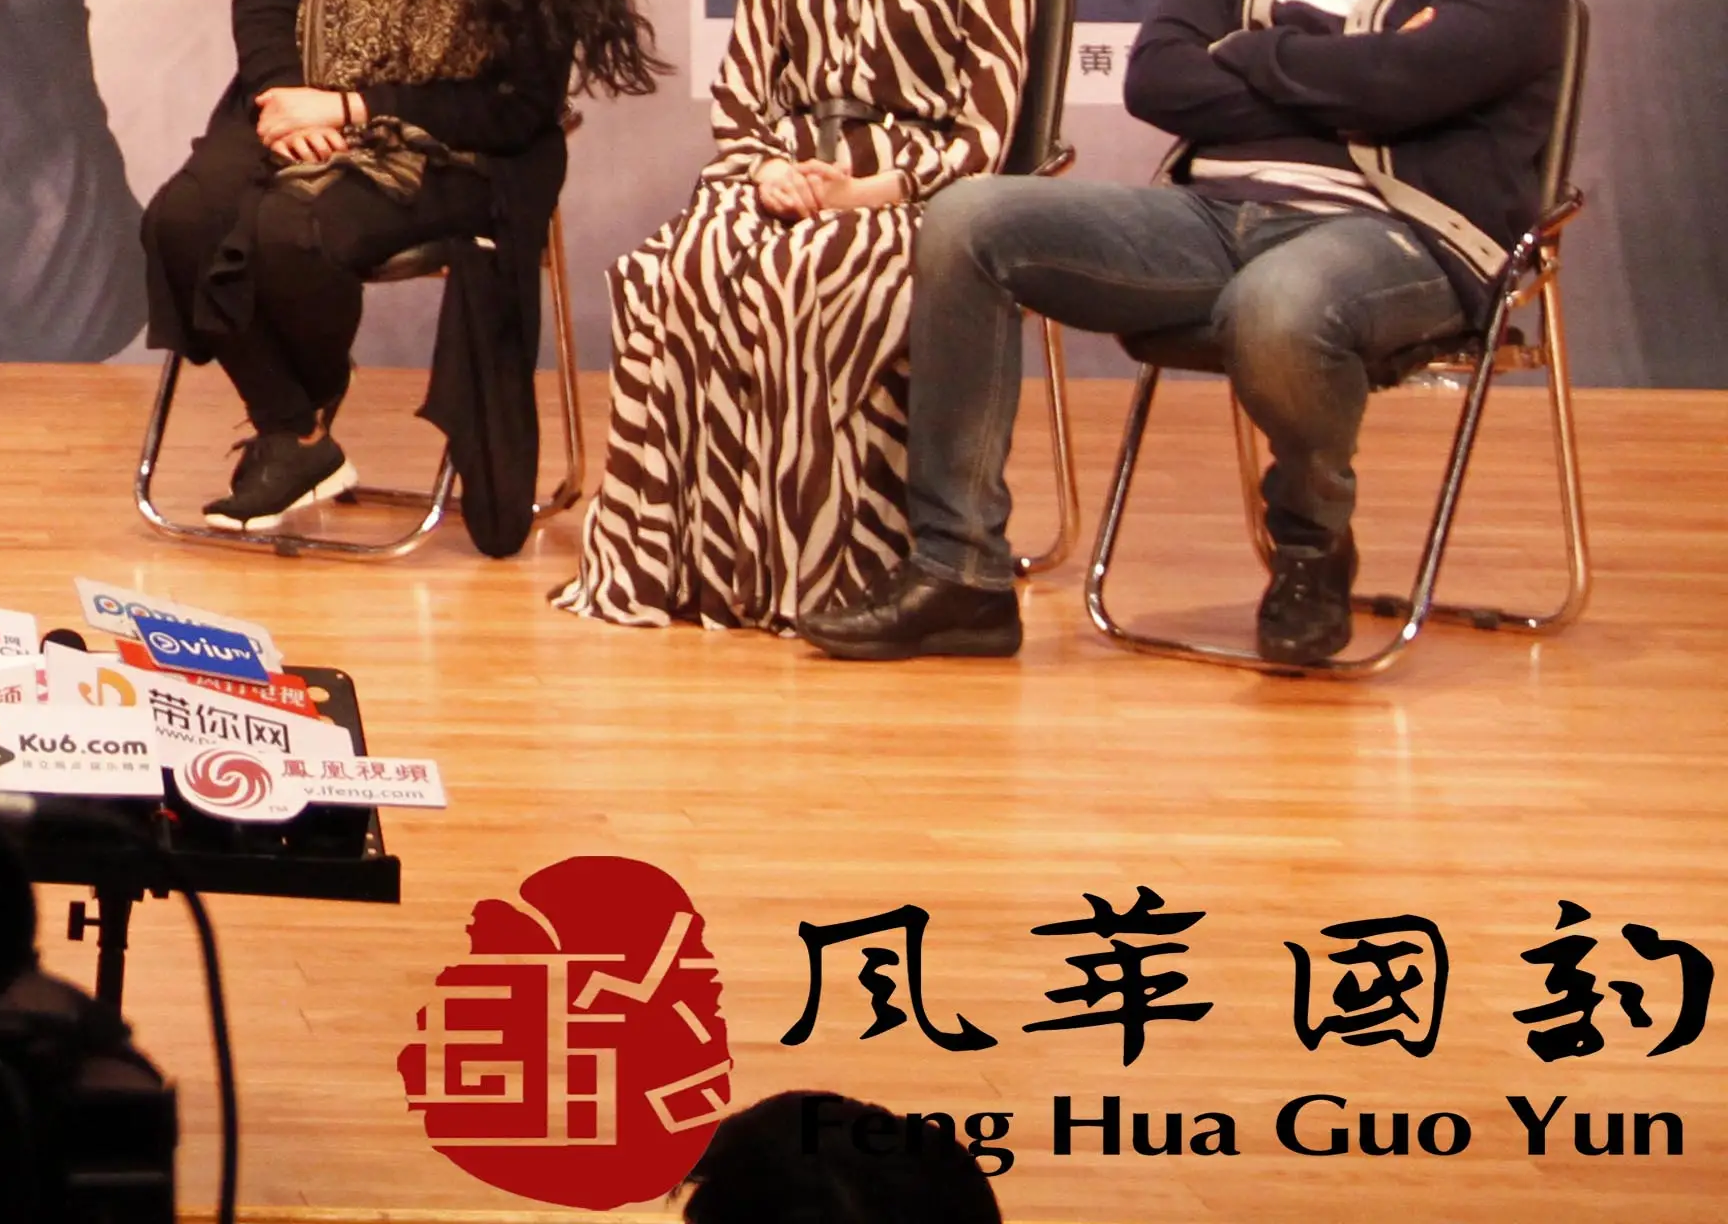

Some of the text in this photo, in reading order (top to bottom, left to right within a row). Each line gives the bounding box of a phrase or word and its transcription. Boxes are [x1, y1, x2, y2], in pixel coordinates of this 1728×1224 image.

[1078, 44, 1133, 76] 黄
[148, 688, 291, 754] 带你网
[19, 733, 148, 756] Ku6.com
